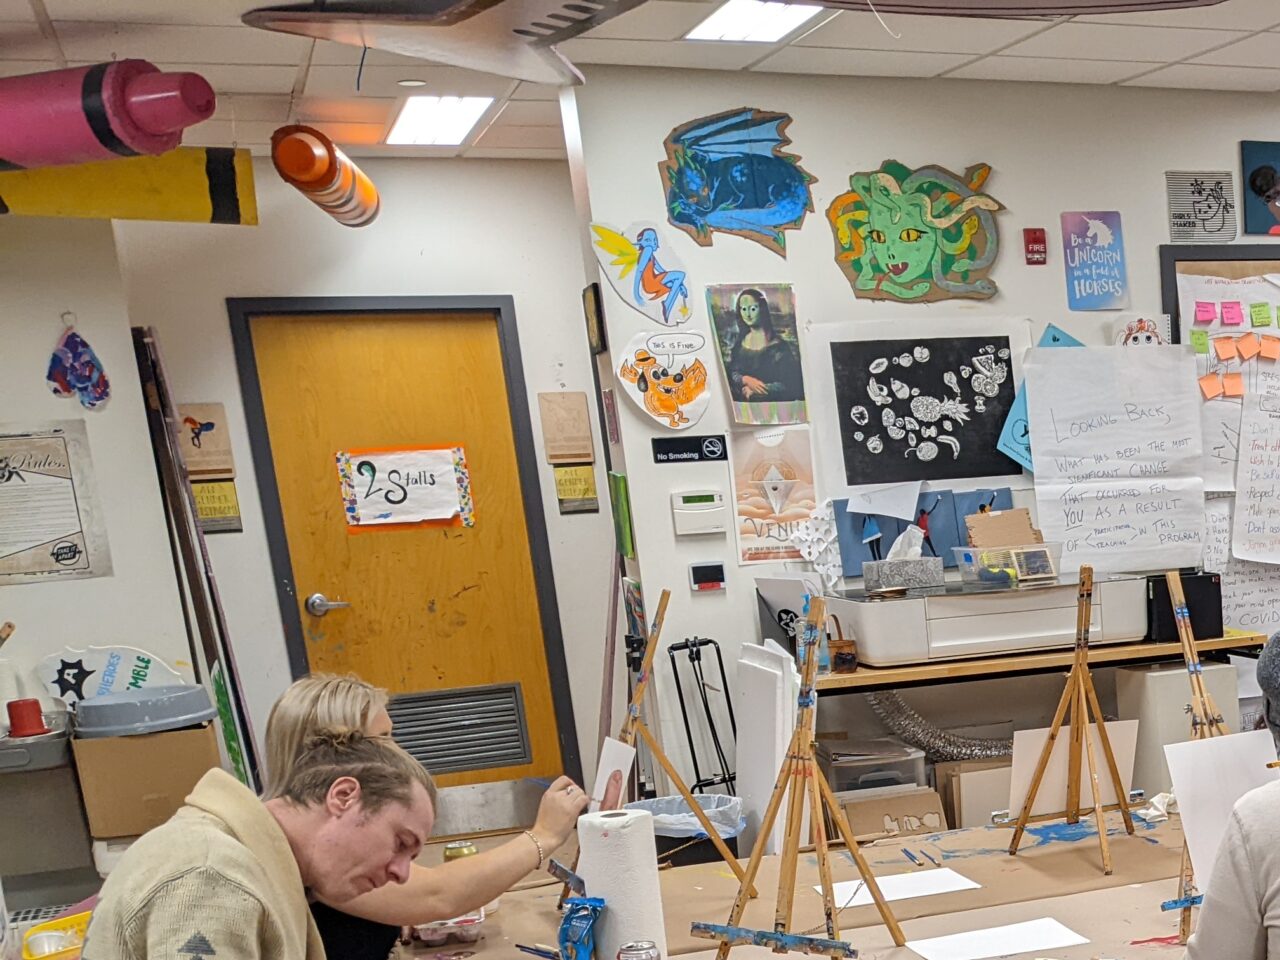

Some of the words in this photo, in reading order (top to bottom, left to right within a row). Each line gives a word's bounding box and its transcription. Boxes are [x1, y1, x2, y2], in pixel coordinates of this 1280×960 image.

[1028, 244, 1046, 252] FIRE
[1067, 245, 1121, 268] UNICORN
[1073, 278, 1122, 300] HORSES
[1050, 407, 1118, 444] LOOKING
[657, 453, 667, 461] No
[668, 452, 699, 461] Smoking
[1055, 455, 1085, 474] WHAT
[1093, 453, 1110, 465] HAS
[1115, 446, 1142, 460] BEEN
[1148, 440, 1166, 453] THE
[1172, 437, 1193, 449] MOST
[1128, 461, 1169, 479] CHANGE
[356, 460, 384, 500] 2
[384, 469, 436, 505] Stalls
[1061, 486, 1090, 507] THAT
[1149, 483, 1170, 495] FOR
[1063, 507, 1085, 527] YOU
[1095, 505, 1112, 521] AS
[1118, 506, 1127, 515] A
[1136, 498, 1182, 514] RESULT
[743, 518, 800, 542] VENU
[1152, 518, 1177, 534] THIS
[1066, 538, 1081, 552] OF
[1158, 531, 1202, 545] PROGRAM
[125, 655, 152, 691] MBLE
